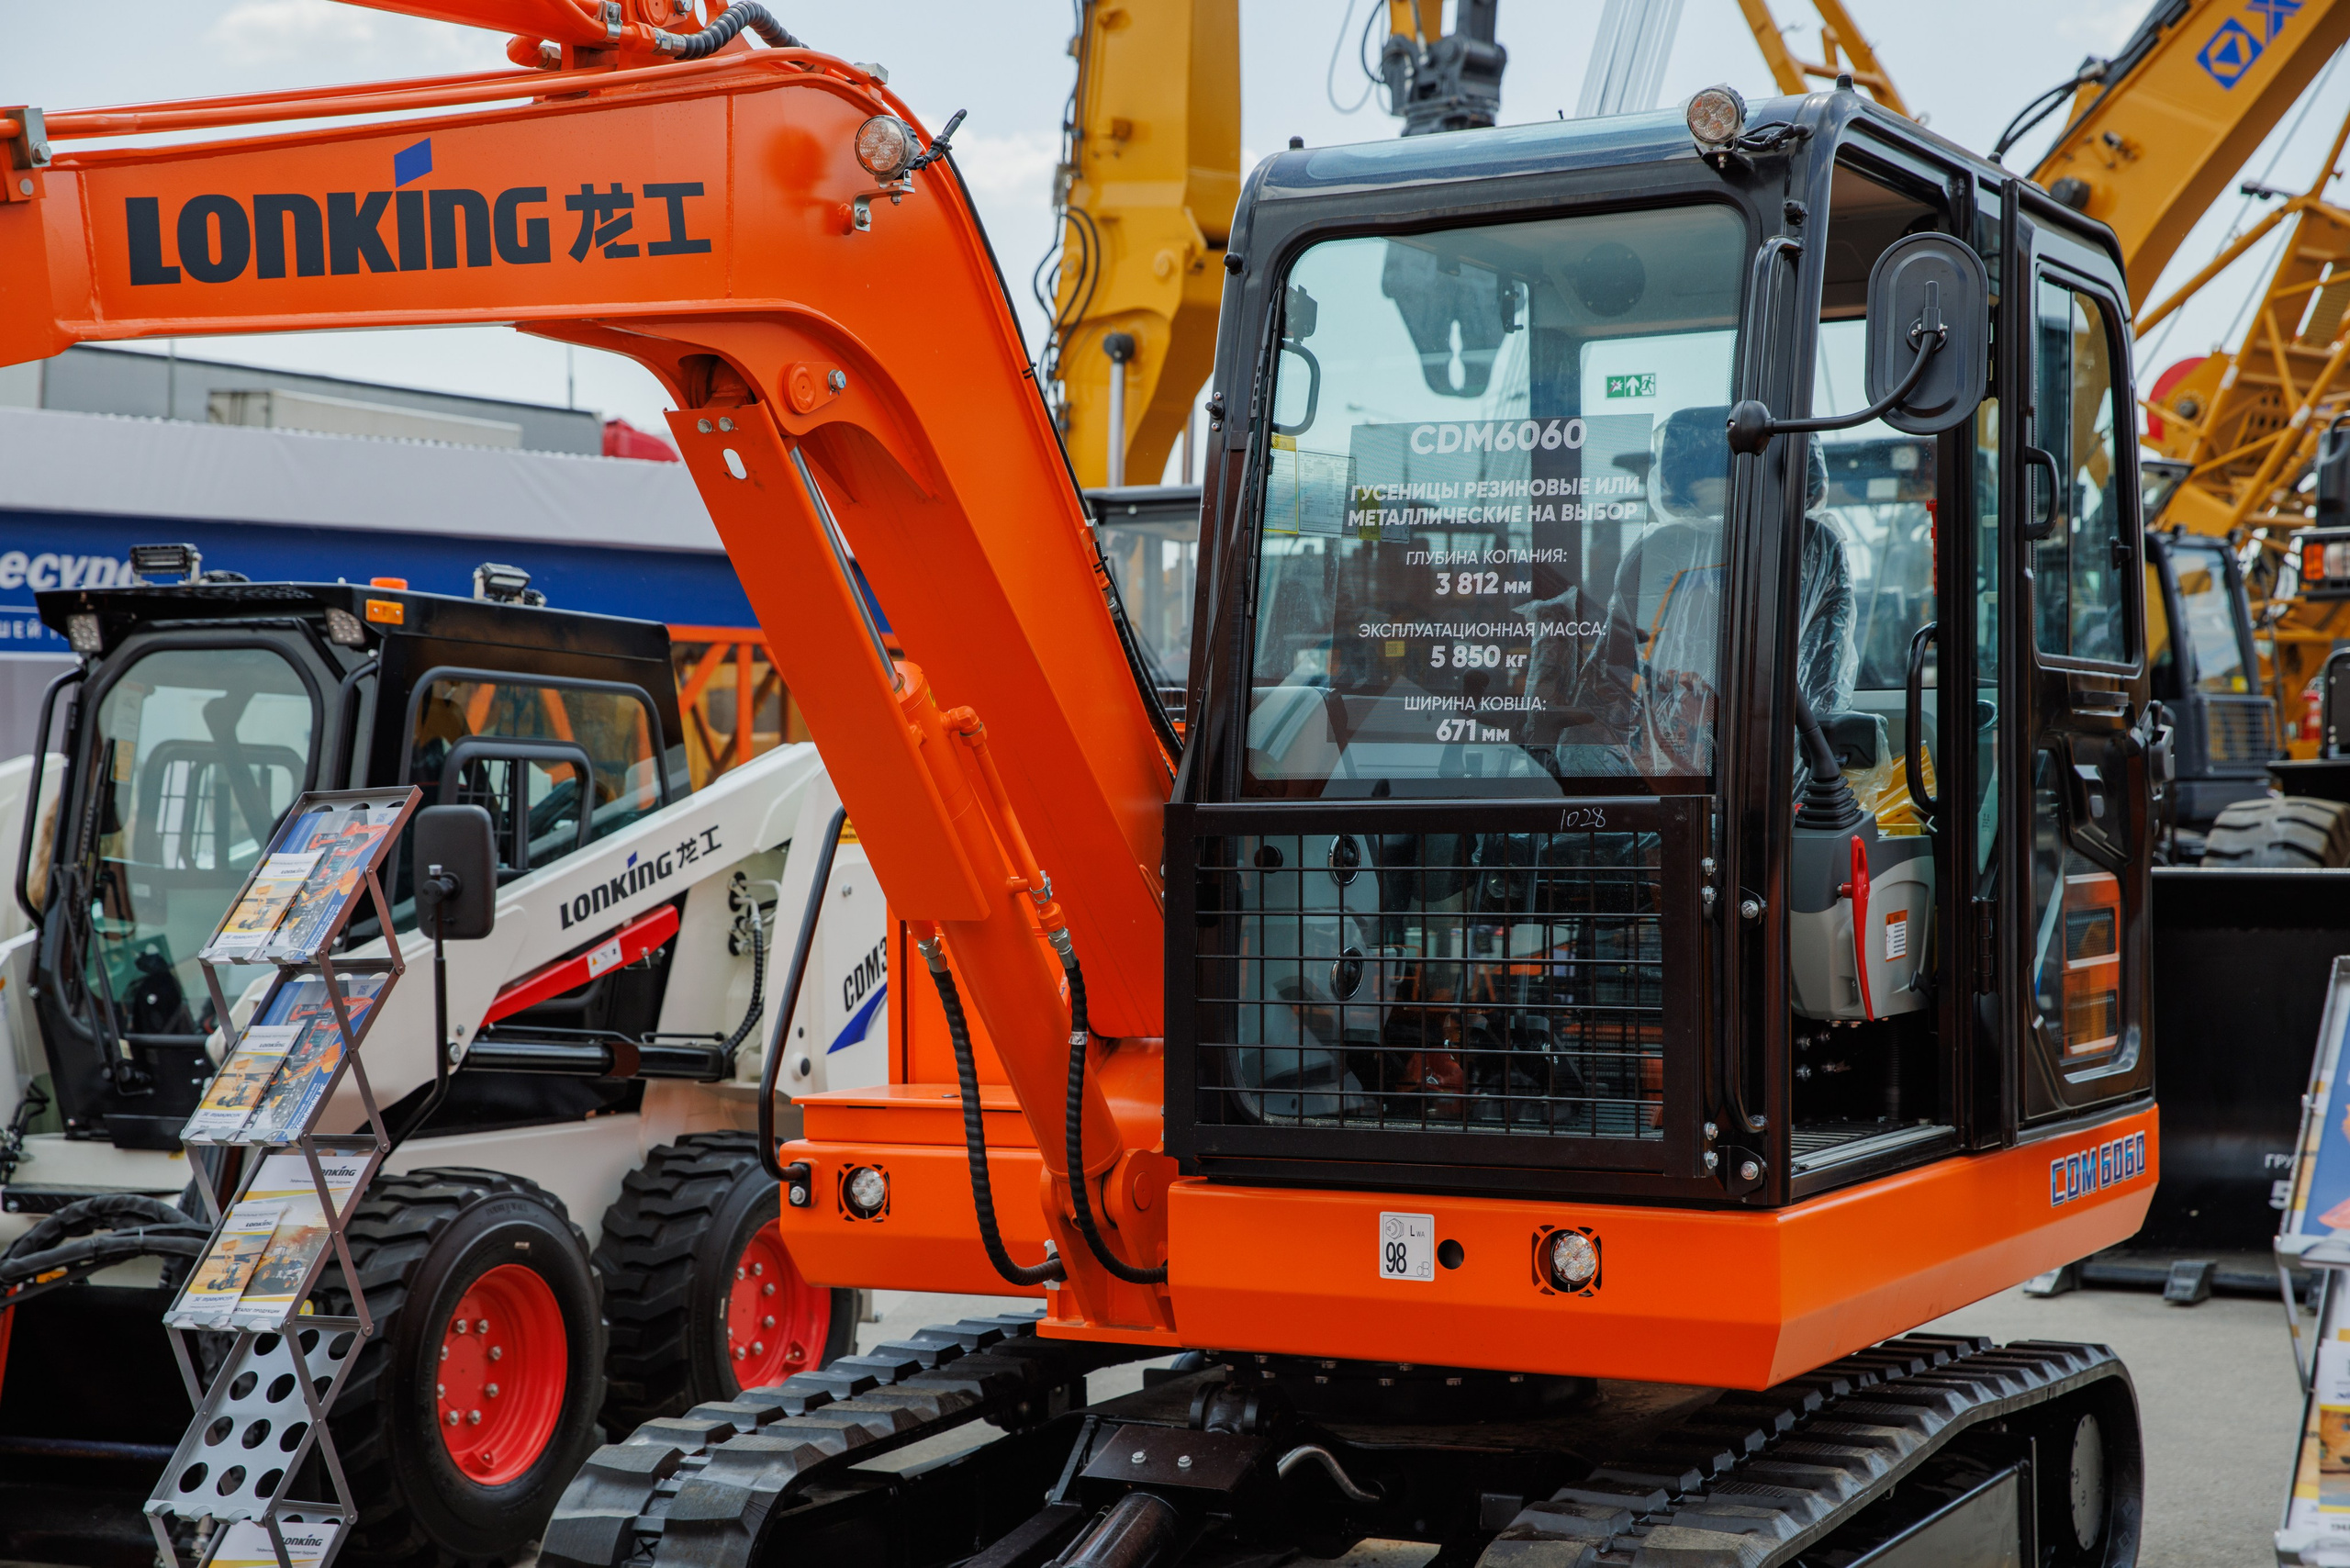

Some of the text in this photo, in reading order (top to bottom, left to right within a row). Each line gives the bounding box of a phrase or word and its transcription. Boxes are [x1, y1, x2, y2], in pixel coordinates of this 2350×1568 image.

[1410, 418, 1587, 454] CDM6060
[1350, 476, 1639, 502] ГУСЕНИЦЫ РЕЗИНОВЫЕ ИЛИ
[1348, 506, 1522, 527] МЕТАЛЛИЧЕСКИЕ
[1528, 506, 1556, 523] НА
[1561, 502, 1638, 521] ВЫБОР
[1405, 548, 1568, 566] ГЛУБИНА КОПАНИЯ:
[1435, 572, 1532, 595] 3 812 мм
[1358, 621, 1607, 640] ЭКСПЛУАТАЦИОННАЯ МАССА:
[1430, 645, 1528, 668] 5 850 кг
[1404, 695, 1547, 711] ШИРИНА КОВША:
[1436, 719, 1510, 742] 671 мм
[1560, 806, 1606, 830] 1028
[1410, 1225, 1415, 1237] L
[1386, 1241, 1407, 1274] 98
